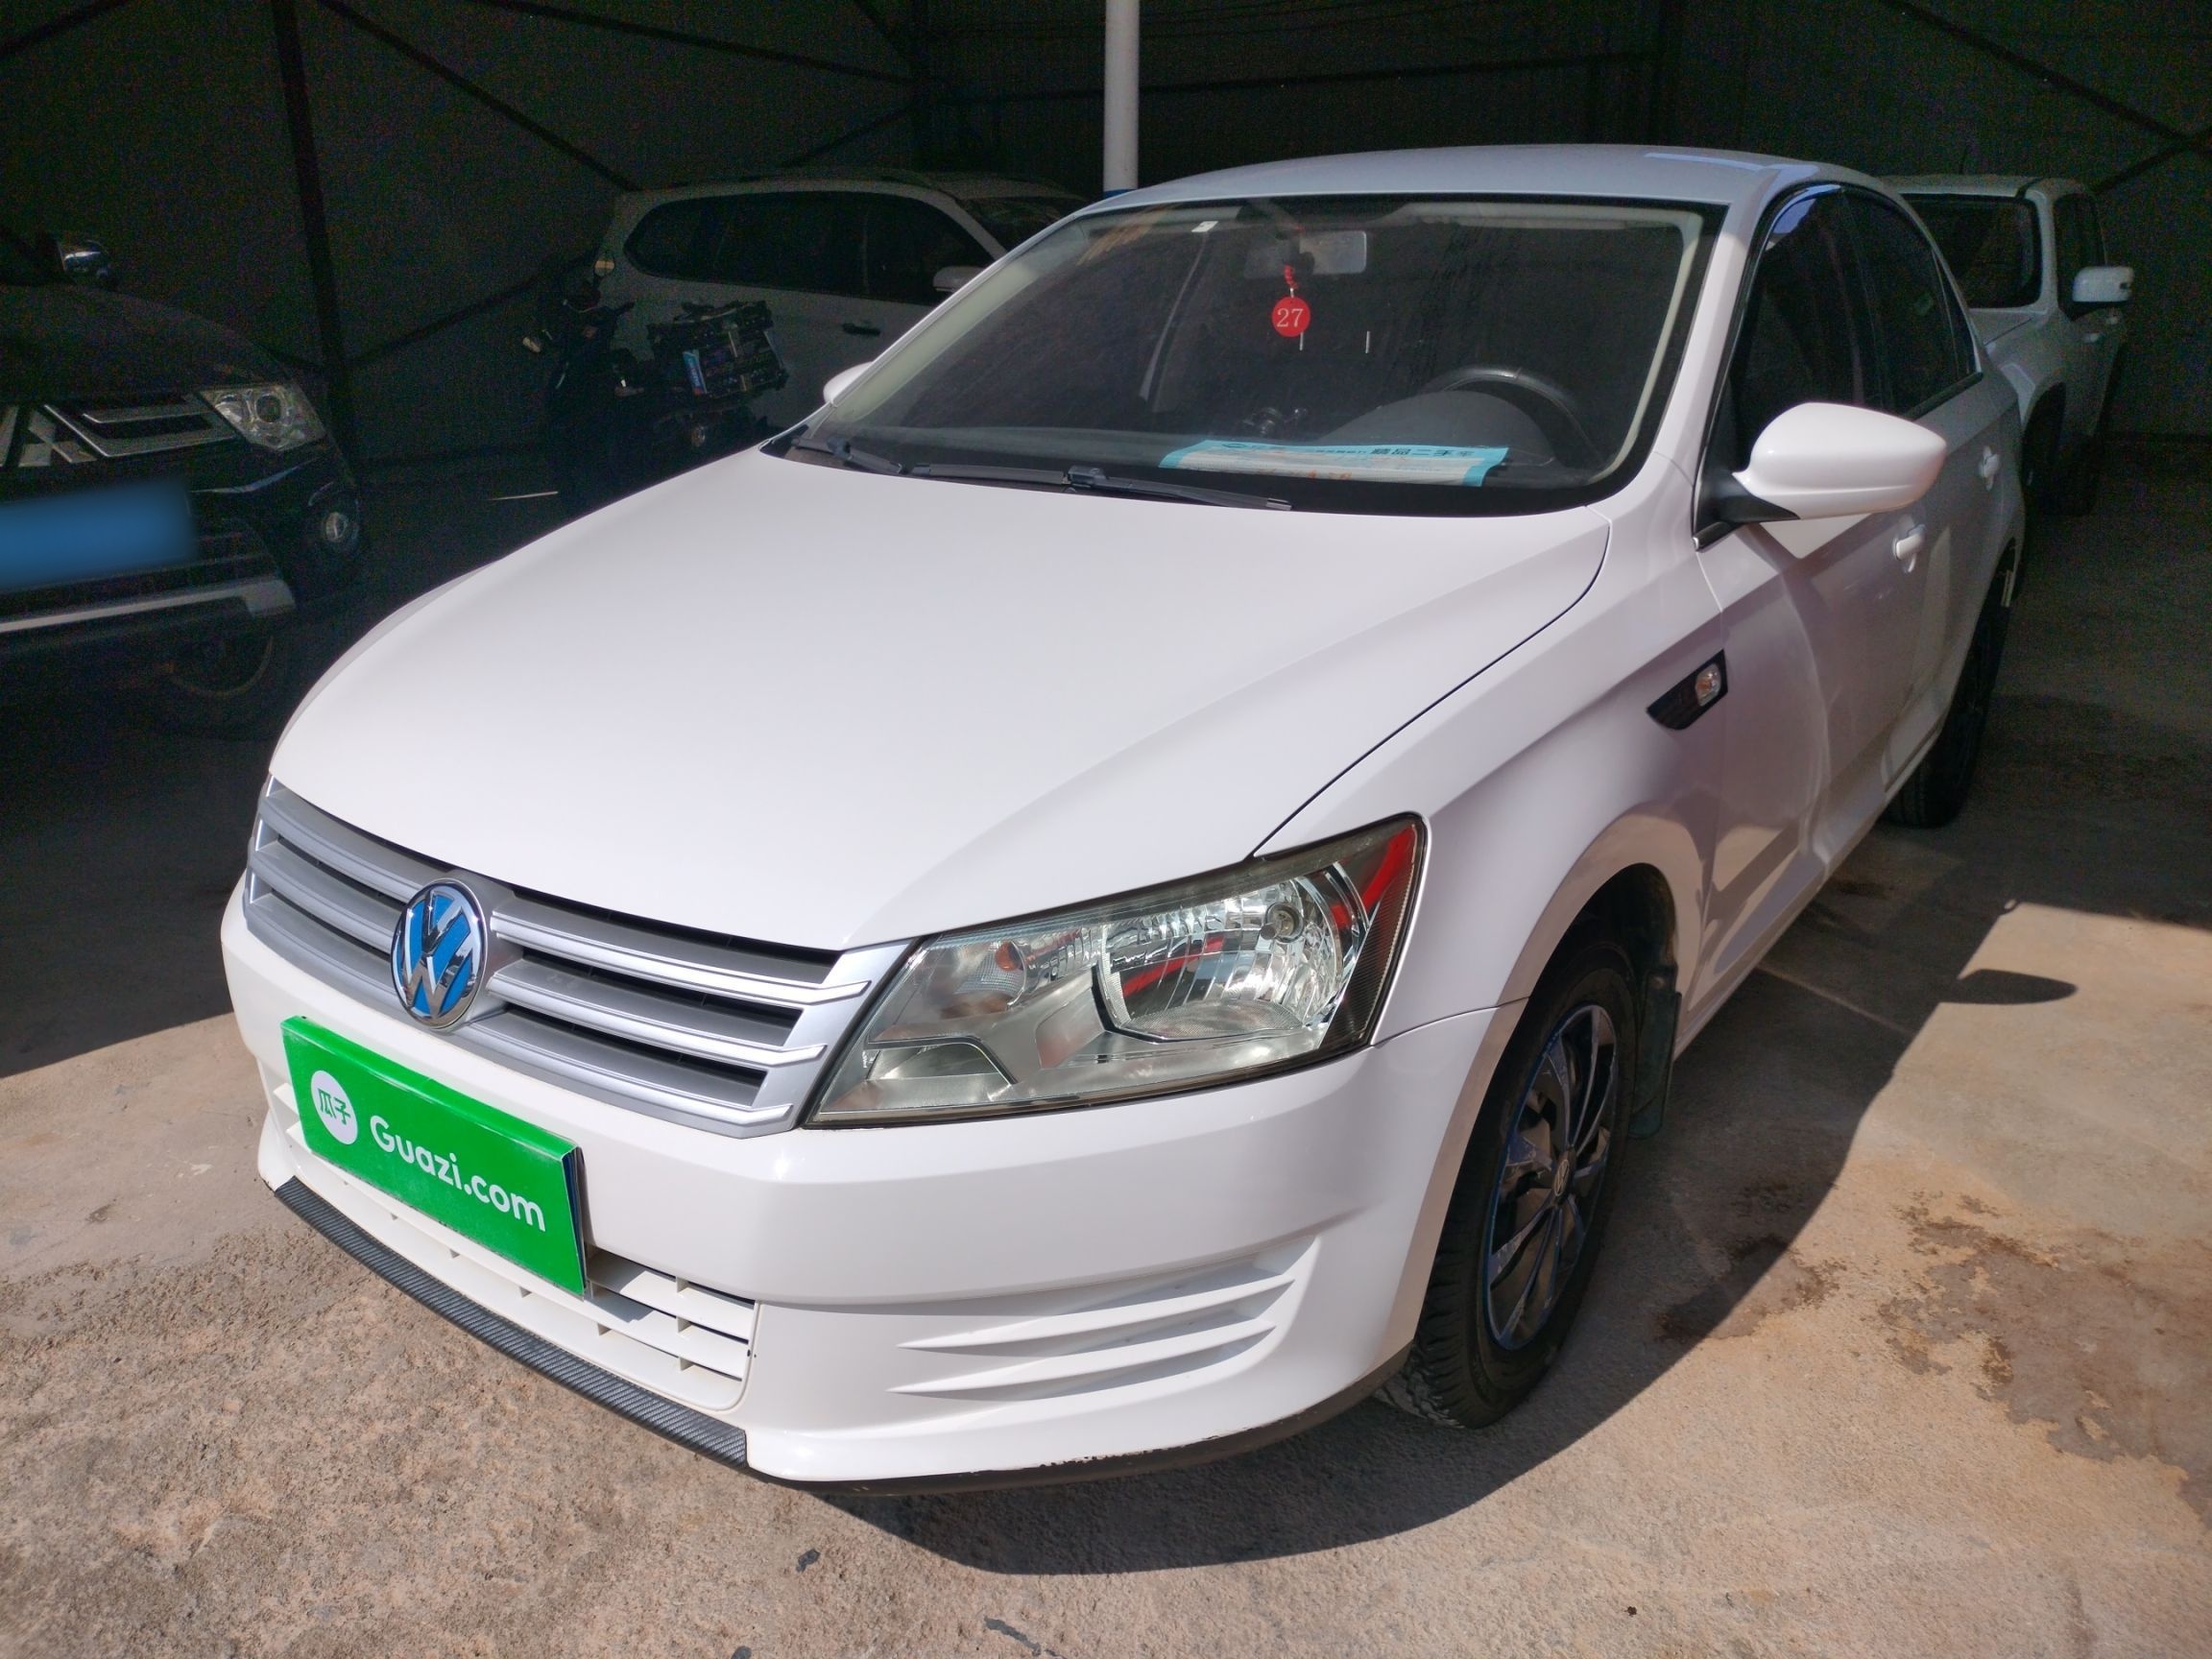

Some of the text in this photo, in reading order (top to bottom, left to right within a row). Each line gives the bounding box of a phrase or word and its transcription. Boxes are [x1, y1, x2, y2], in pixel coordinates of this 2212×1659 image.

[1276, 308, 1304, 327] 27
[317, 1087, 351, 1125] 瓜子
[370, 1115, 546, 1232] Guazi.com
